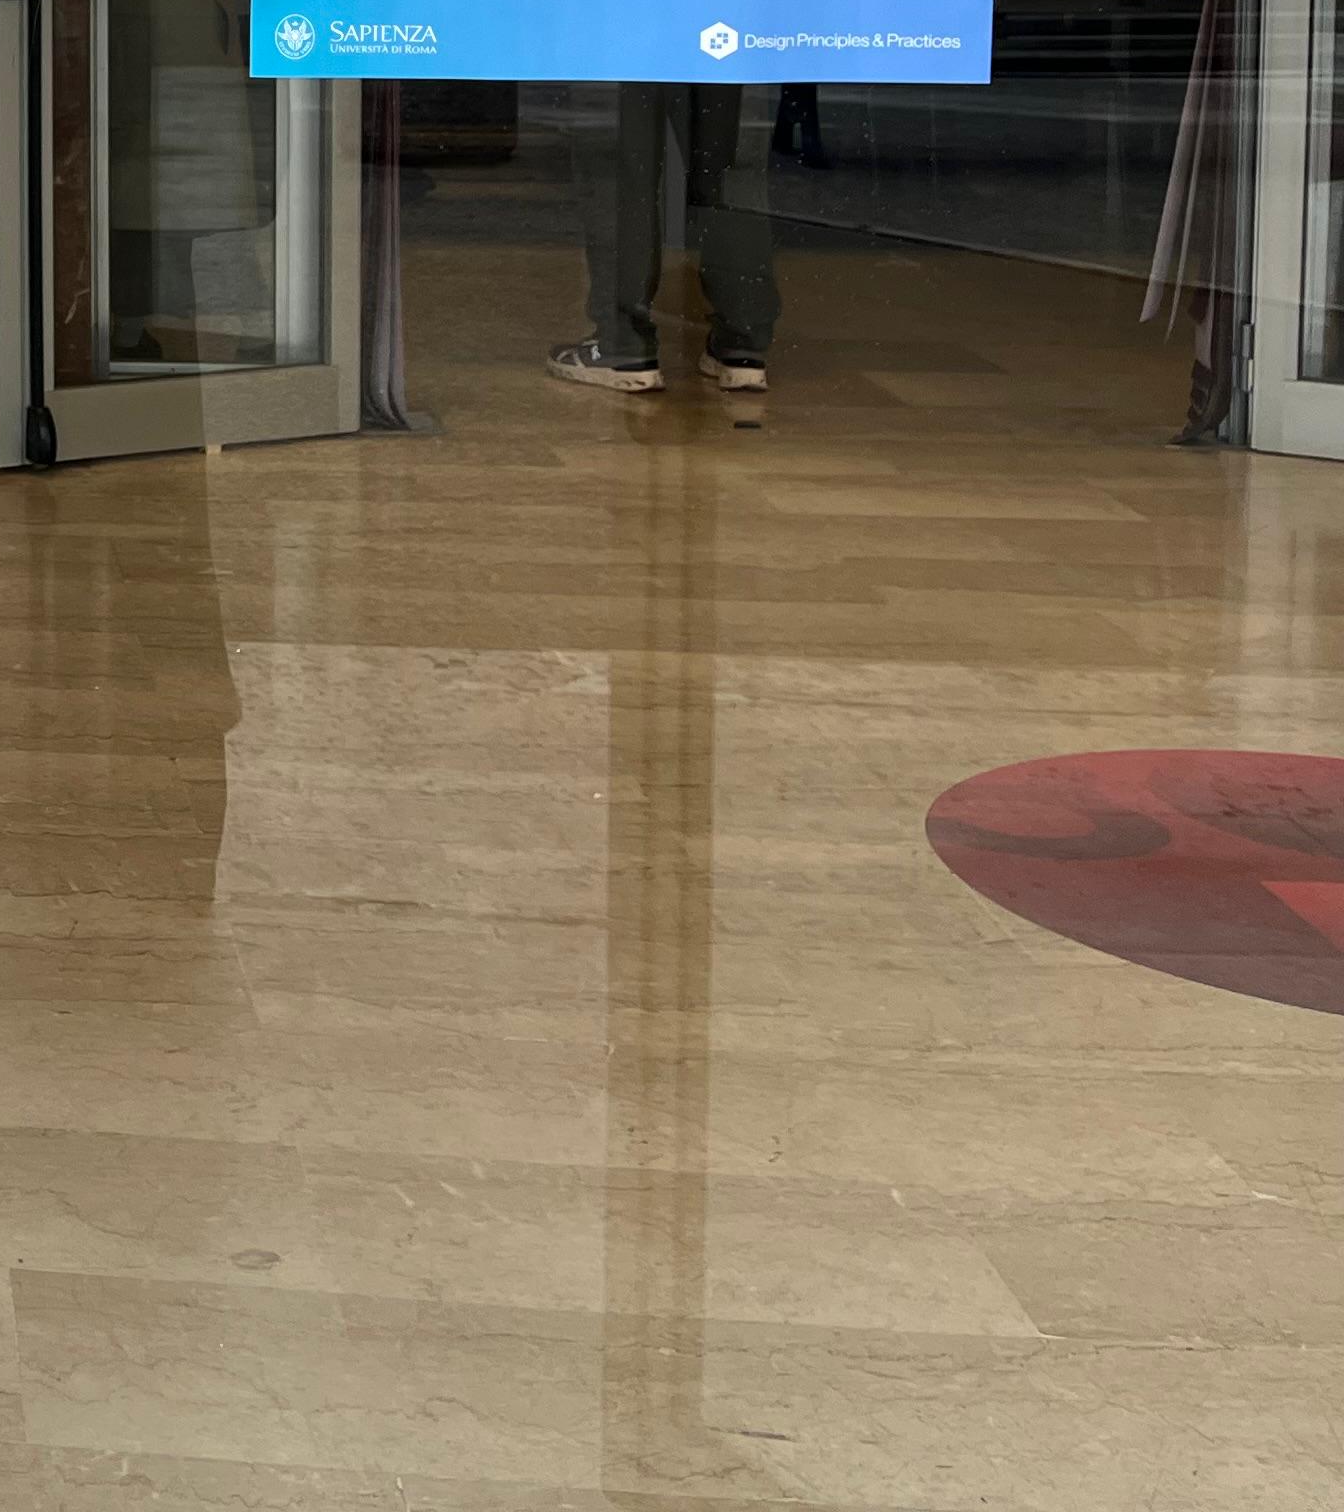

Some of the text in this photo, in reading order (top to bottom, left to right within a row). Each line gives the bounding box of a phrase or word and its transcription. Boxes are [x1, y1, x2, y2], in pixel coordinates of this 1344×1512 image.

[330, 20, 438, 43] SAPIENZA
[330, 43, 438, 55] UNIVERSITÀ DI ROMA
[744, 32, 961, 51] Design Principles & Practices
